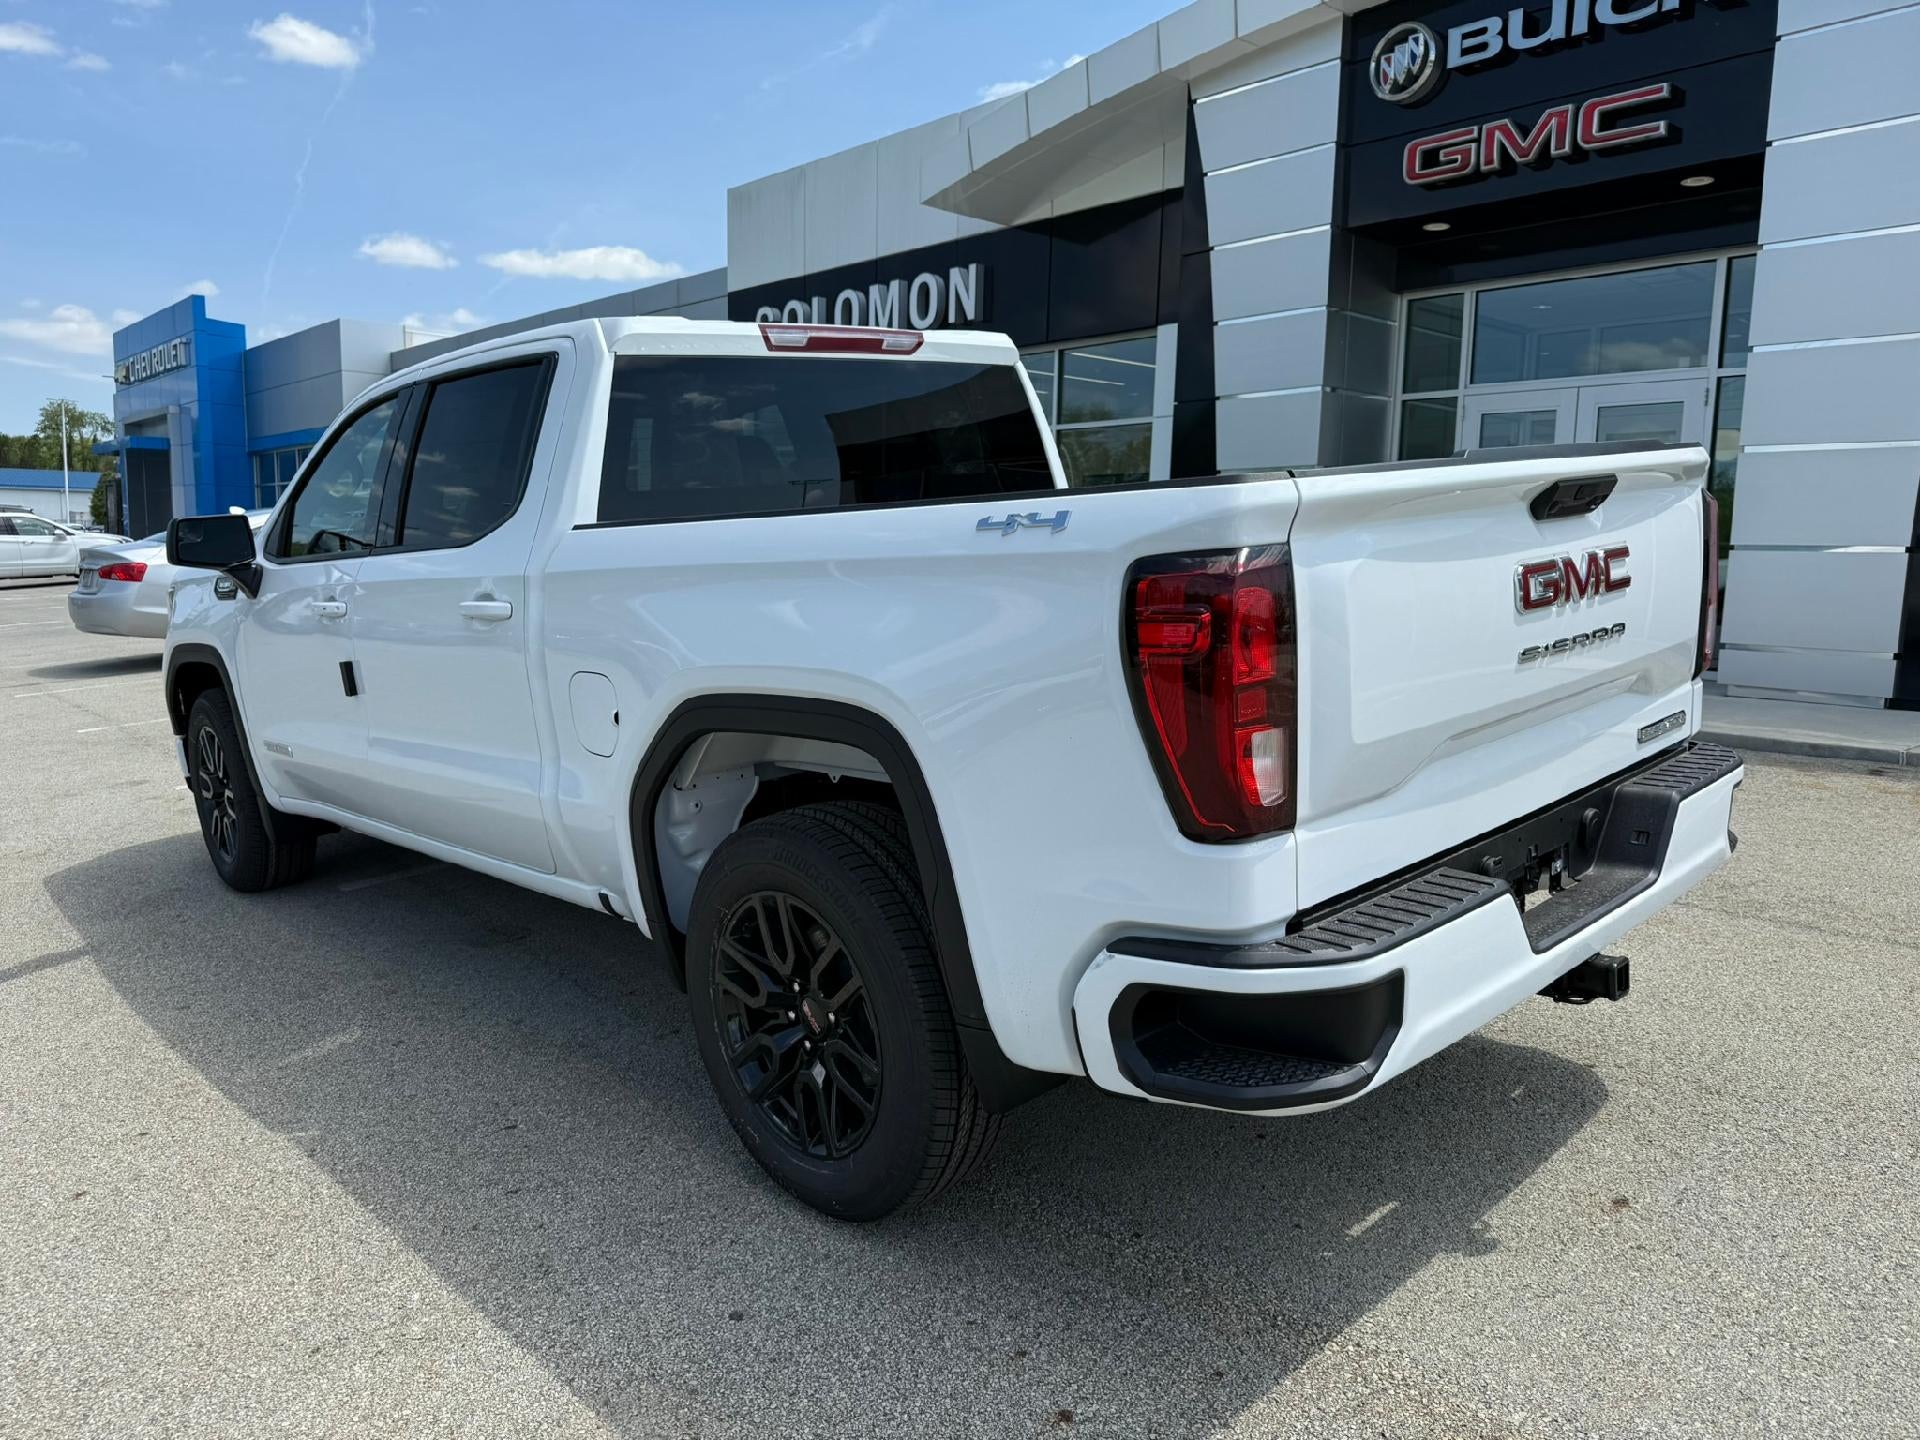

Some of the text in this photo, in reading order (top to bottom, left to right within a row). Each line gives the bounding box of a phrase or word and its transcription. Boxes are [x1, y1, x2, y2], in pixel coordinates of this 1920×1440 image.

[1447, 0, 1706, 69] BUIC
[1403, 82, 1673, 185] GMC
[129, 338, 190, 383] CHEVROLET
[1514, 542, 1632, 615] GMC
[1518, 622, 1626, 665] SIERRA
[772, 844, 863, 924] BRIDGESTONE
